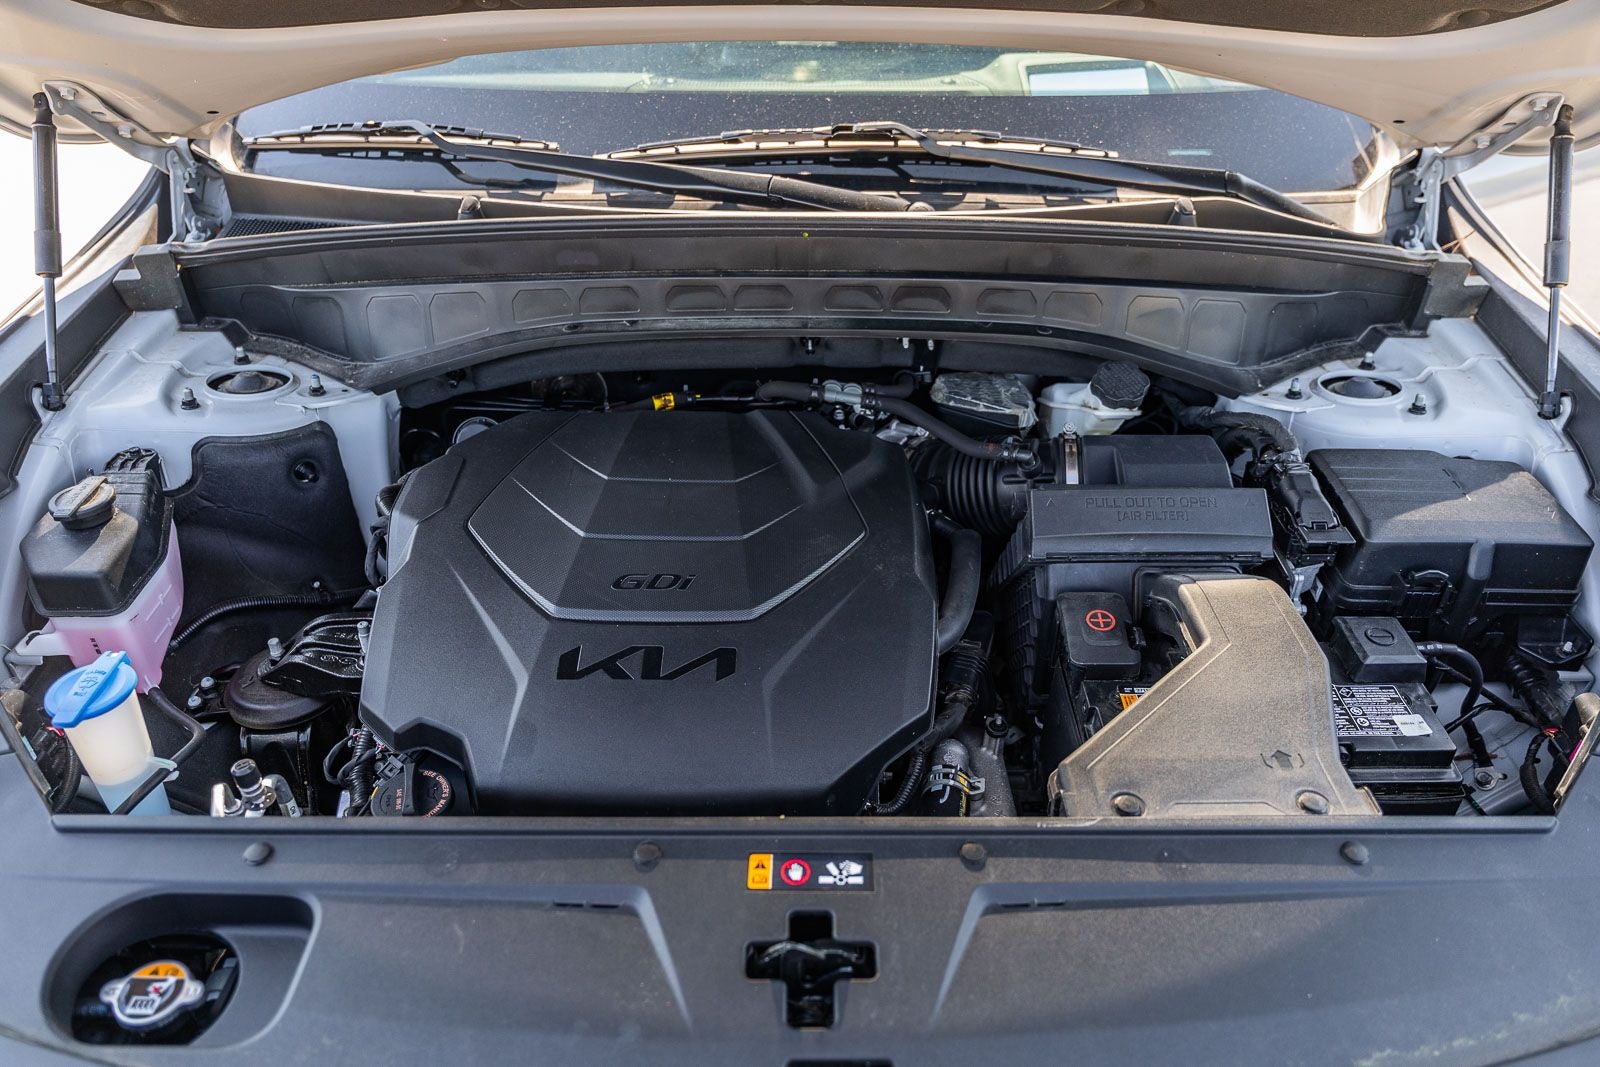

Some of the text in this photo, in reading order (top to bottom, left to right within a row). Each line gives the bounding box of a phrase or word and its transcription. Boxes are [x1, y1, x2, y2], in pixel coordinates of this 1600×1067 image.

[1085, 496, 1218, 509] PULL OUT TO OPEN
[610, 573, 697, 591] GDi
[556, 644, 737, 683] KIA
[422, 769, 437, 778] SEE
[424, 799, 447, 818] MANUA
